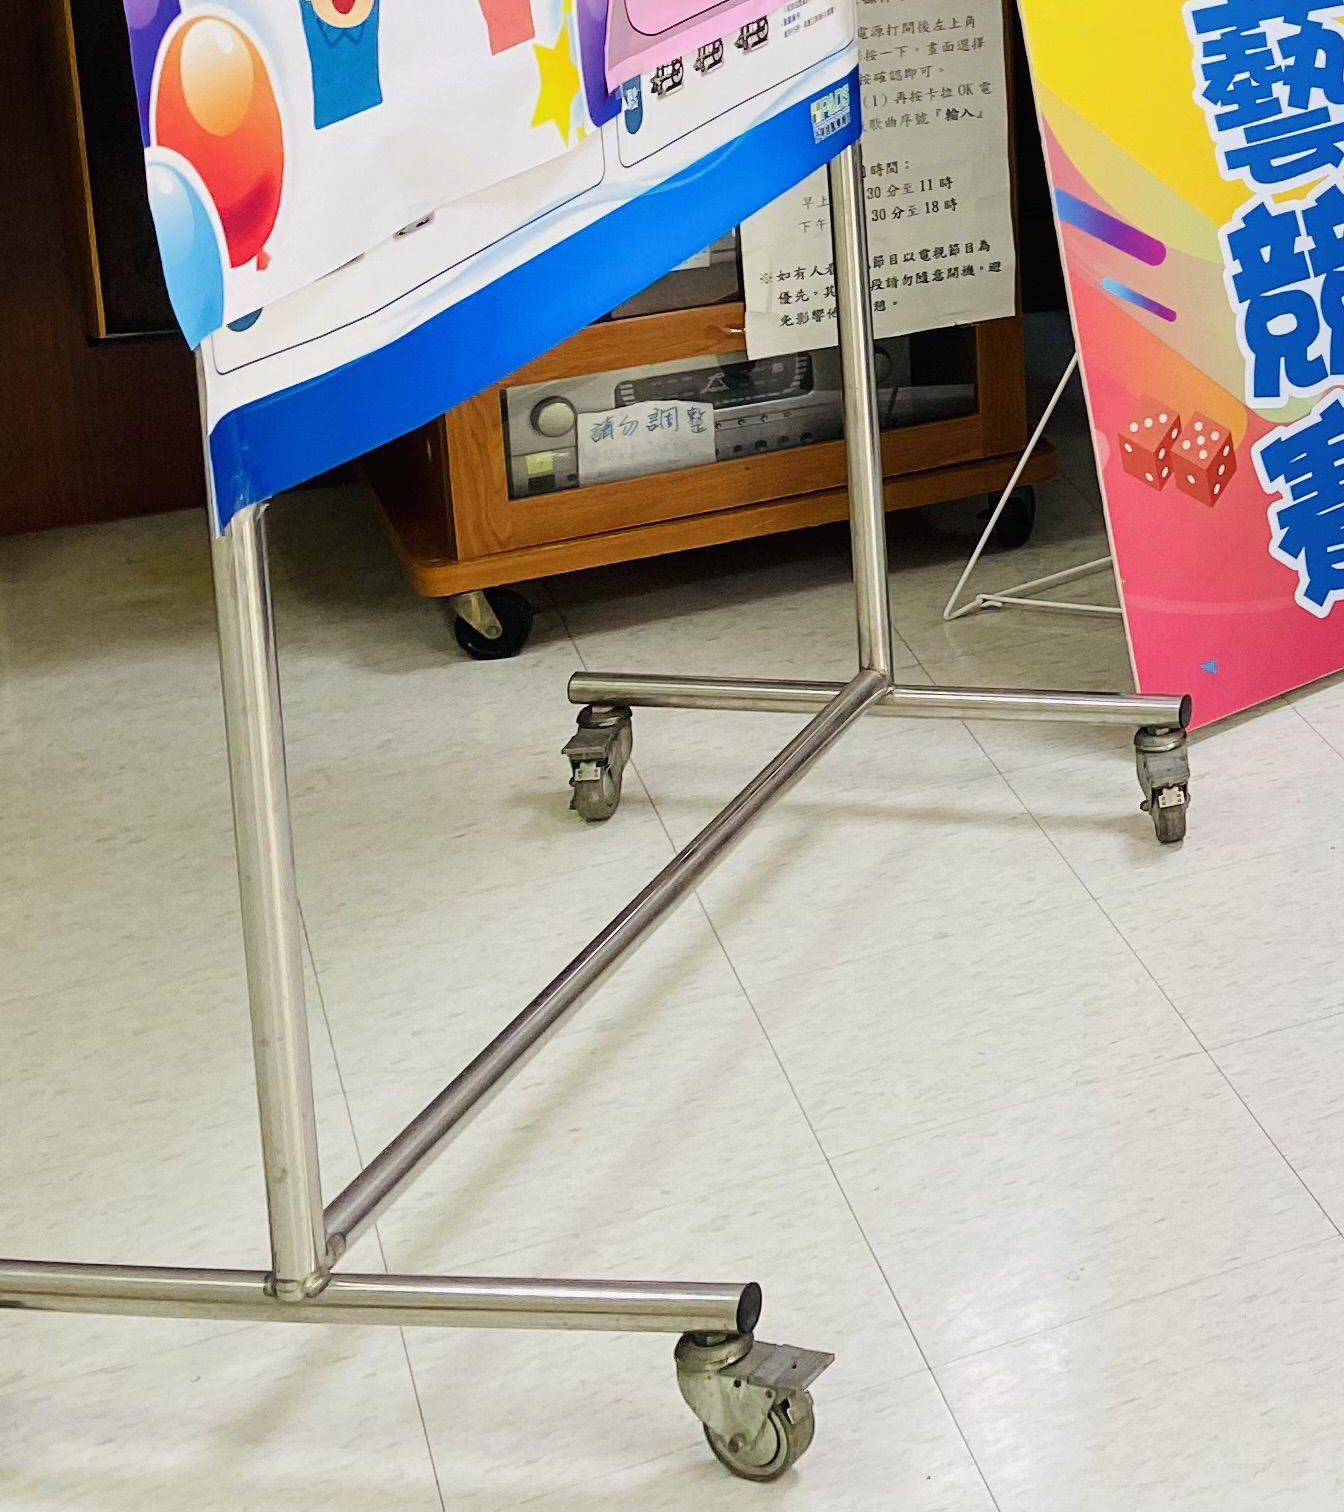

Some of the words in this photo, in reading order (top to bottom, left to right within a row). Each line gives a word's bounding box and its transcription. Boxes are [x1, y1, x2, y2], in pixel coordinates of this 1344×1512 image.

[858, 37, 984, 61] 按一下，畫面選擇
[862, 108, 983, 132] 歌曲序號『輸入』
[862, 160, 910, 178] 時間：
[800, 218, 827, 233] 下午
[868, 239, 991, 271] 節目以電視節目為
[591, 406, 707, 443] 請勿調整
